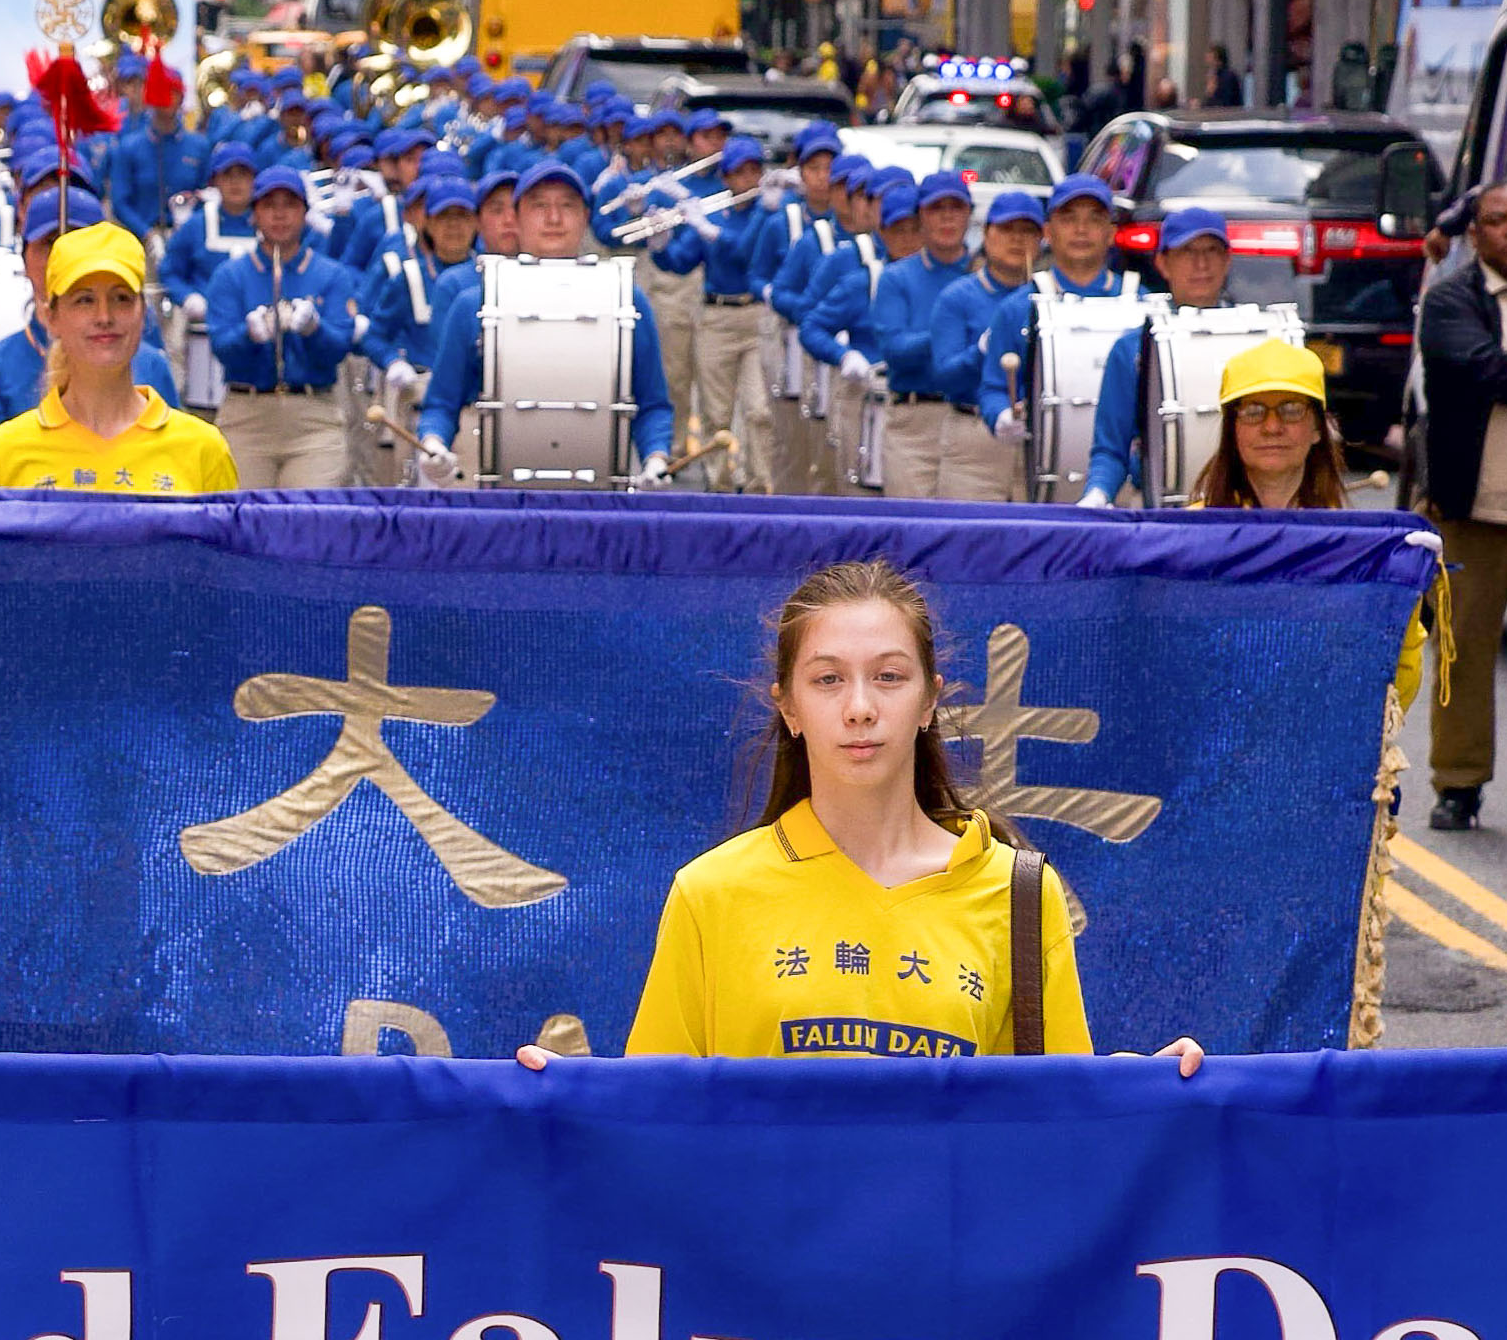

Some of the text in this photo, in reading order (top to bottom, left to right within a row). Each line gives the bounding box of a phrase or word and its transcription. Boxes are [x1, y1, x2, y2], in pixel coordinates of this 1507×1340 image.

[774, 940, 985, 1002] 法輪大法
[790, 1023, 962, 1059] FALUN DAFA
